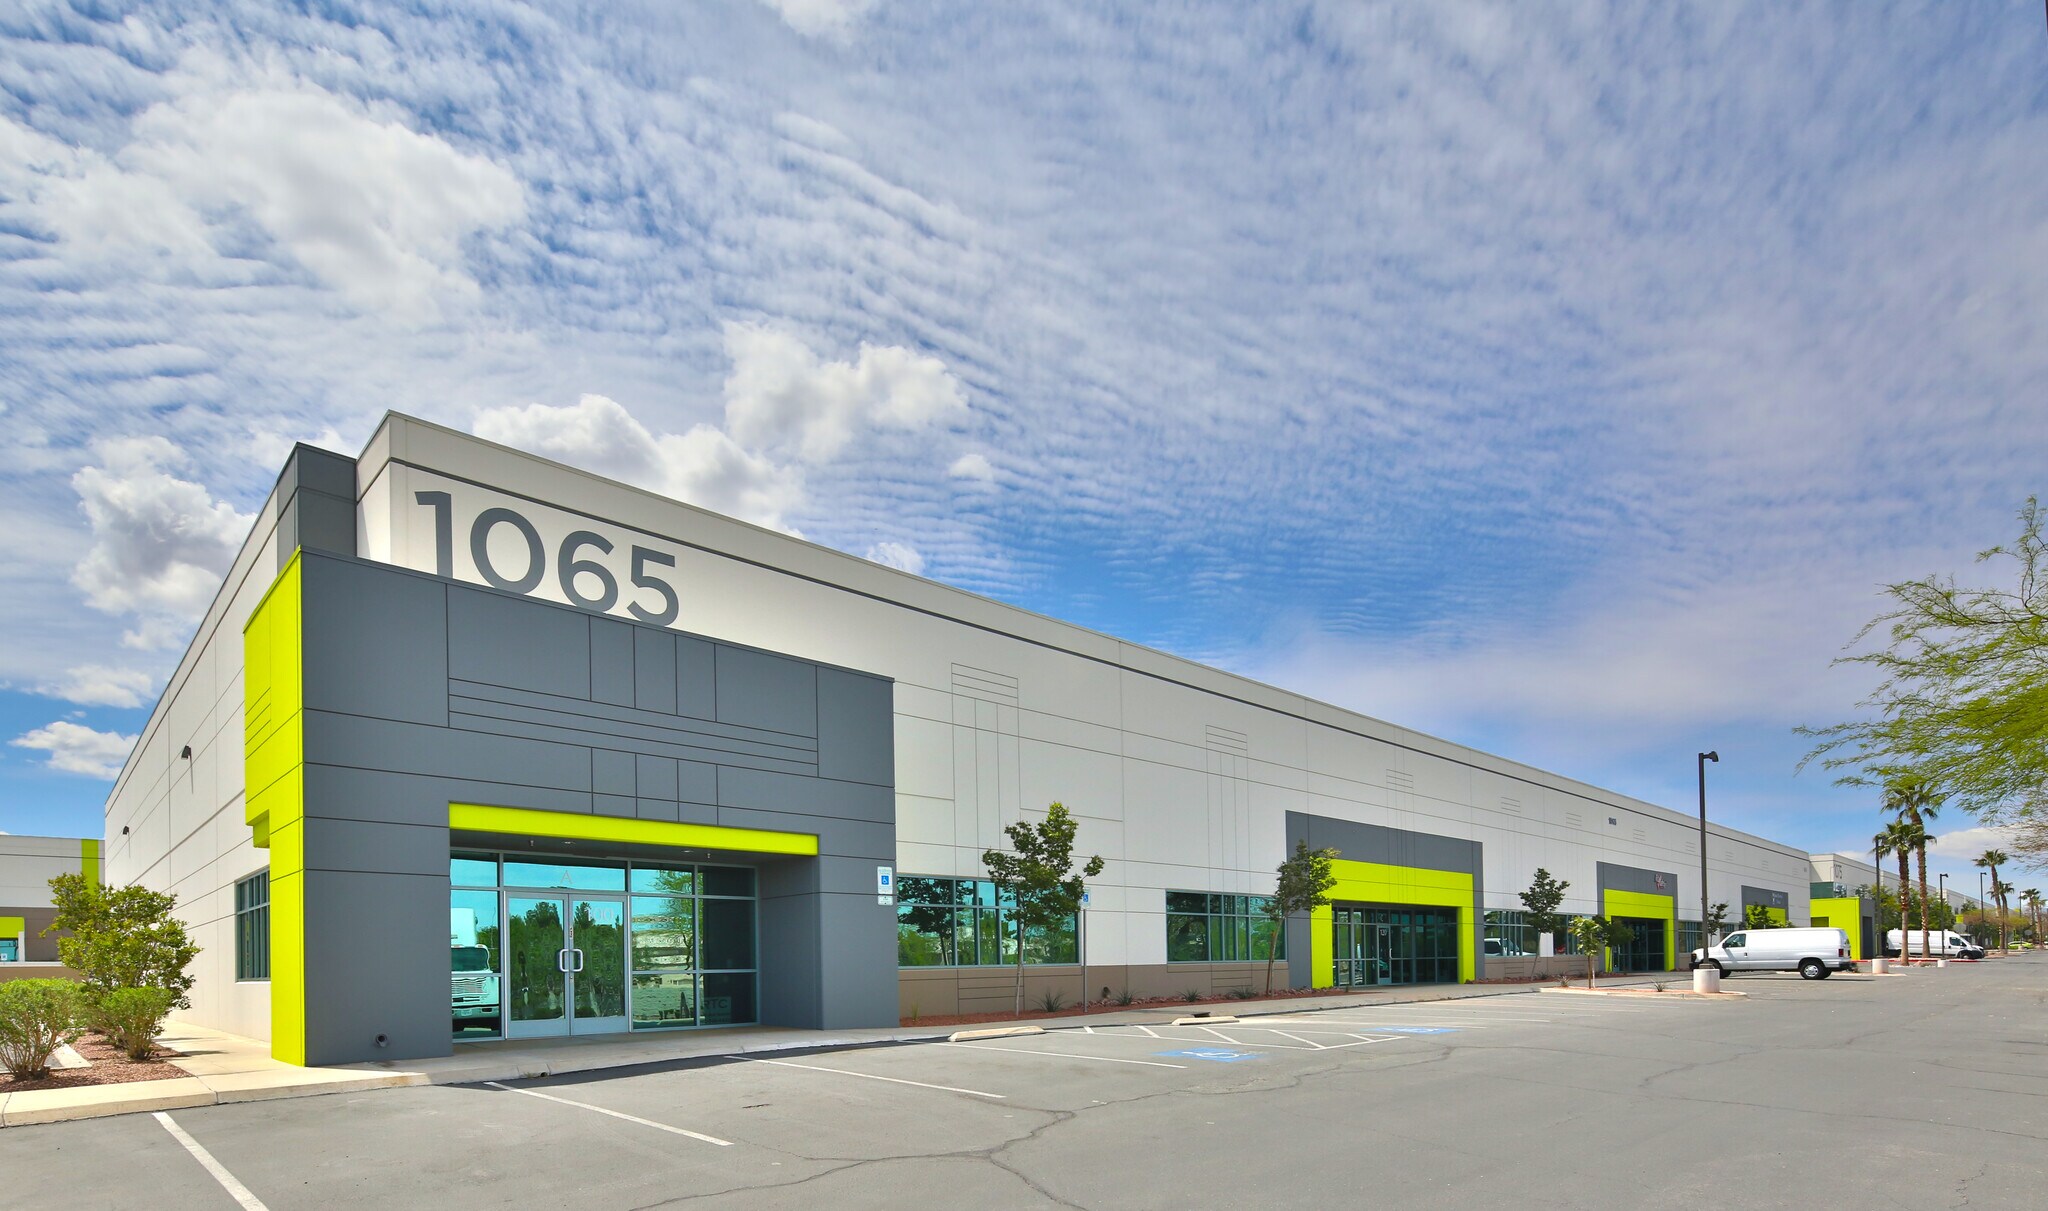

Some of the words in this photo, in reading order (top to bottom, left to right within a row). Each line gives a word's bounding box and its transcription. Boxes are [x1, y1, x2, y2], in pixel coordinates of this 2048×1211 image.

[414, 491, 679, 627] 1065
[561, 869, 573, 885] A
[584, 907, 614, 921] 100
